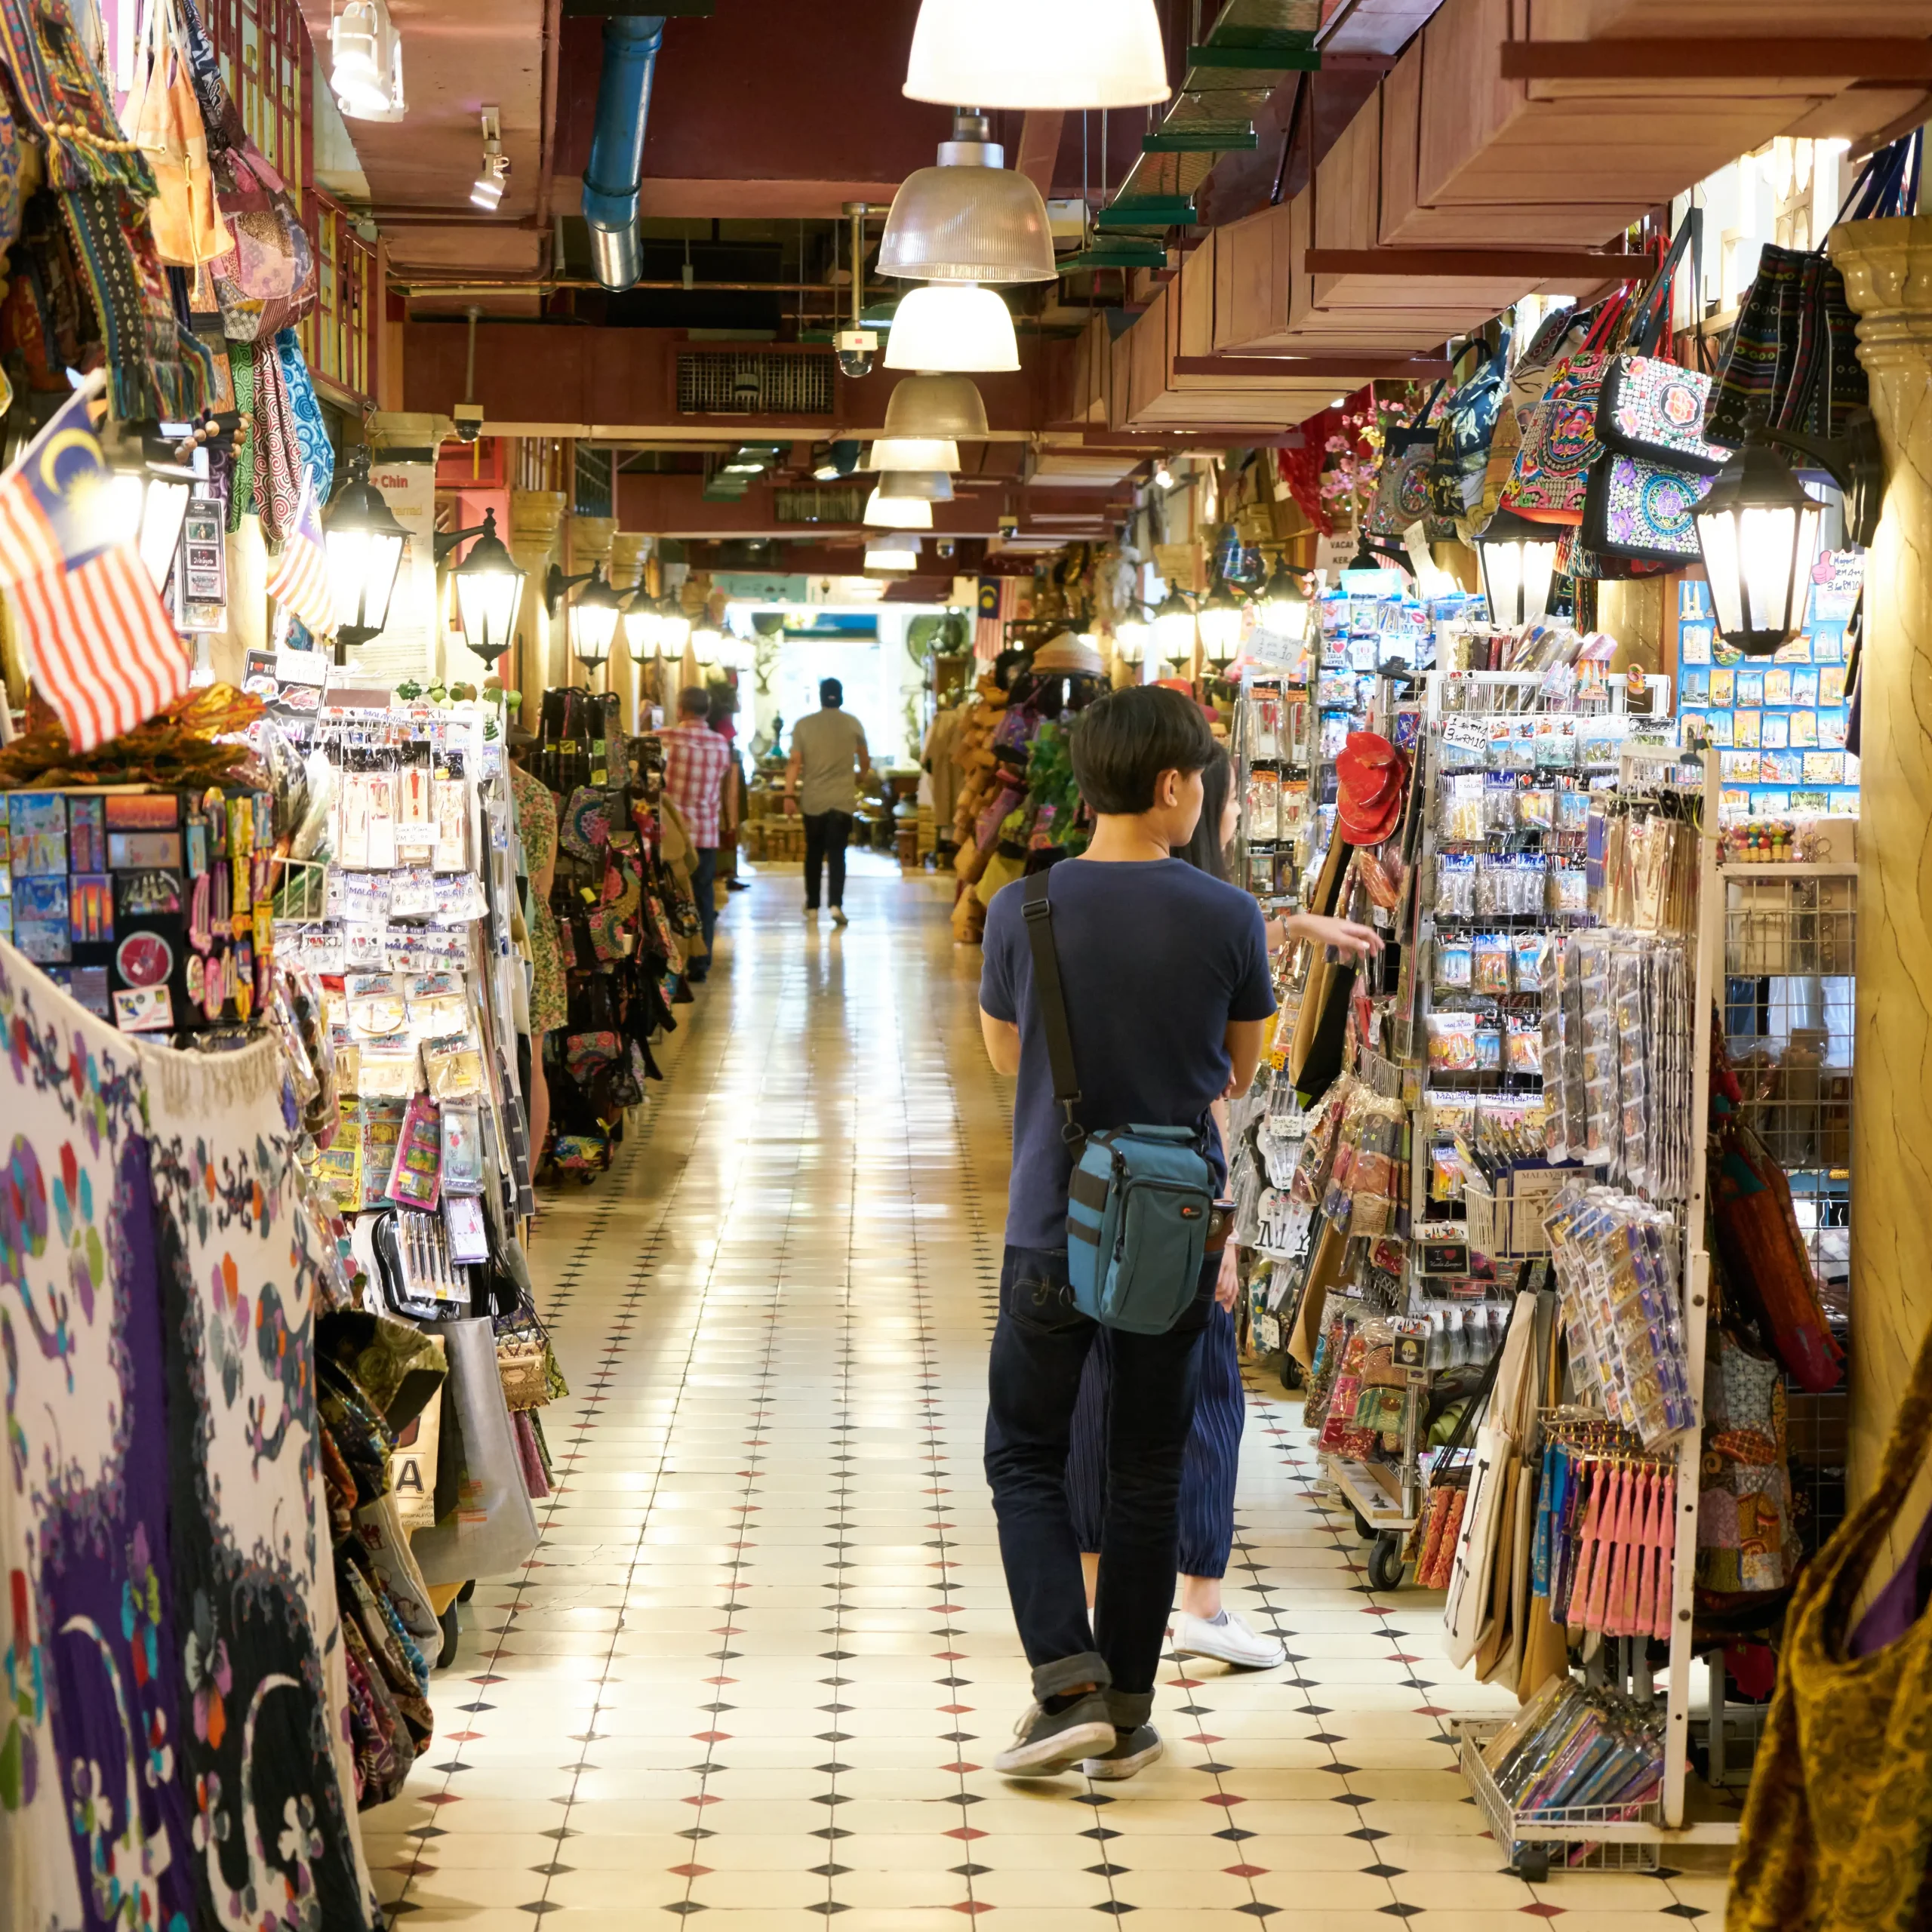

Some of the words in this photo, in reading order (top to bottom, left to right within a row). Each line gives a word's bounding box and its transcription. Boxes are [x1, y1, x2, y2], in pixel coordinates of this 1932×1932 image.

[381, 475, 408, 488] Chin
[1826, 581, 1834, 592] 3
[1405, 613, 1411, 623] I
[1402, 625, 1426, 635] MY
[1278, 651, 1293, 661] 10
[248, 662, 254, 671] I
[362, 708, 402, 723] MALAYSIA
[1449, 717, 1457, 726] 1
[1443, 728, 1456, 740] 3
[349, 885, 388, 900] MALAYSIA
[385, 941, 425, 953] MALAYSIA
[1521, 1171, 1571, 1179] MALAYSIA
[1434, 1250, 1441, 1260] I
